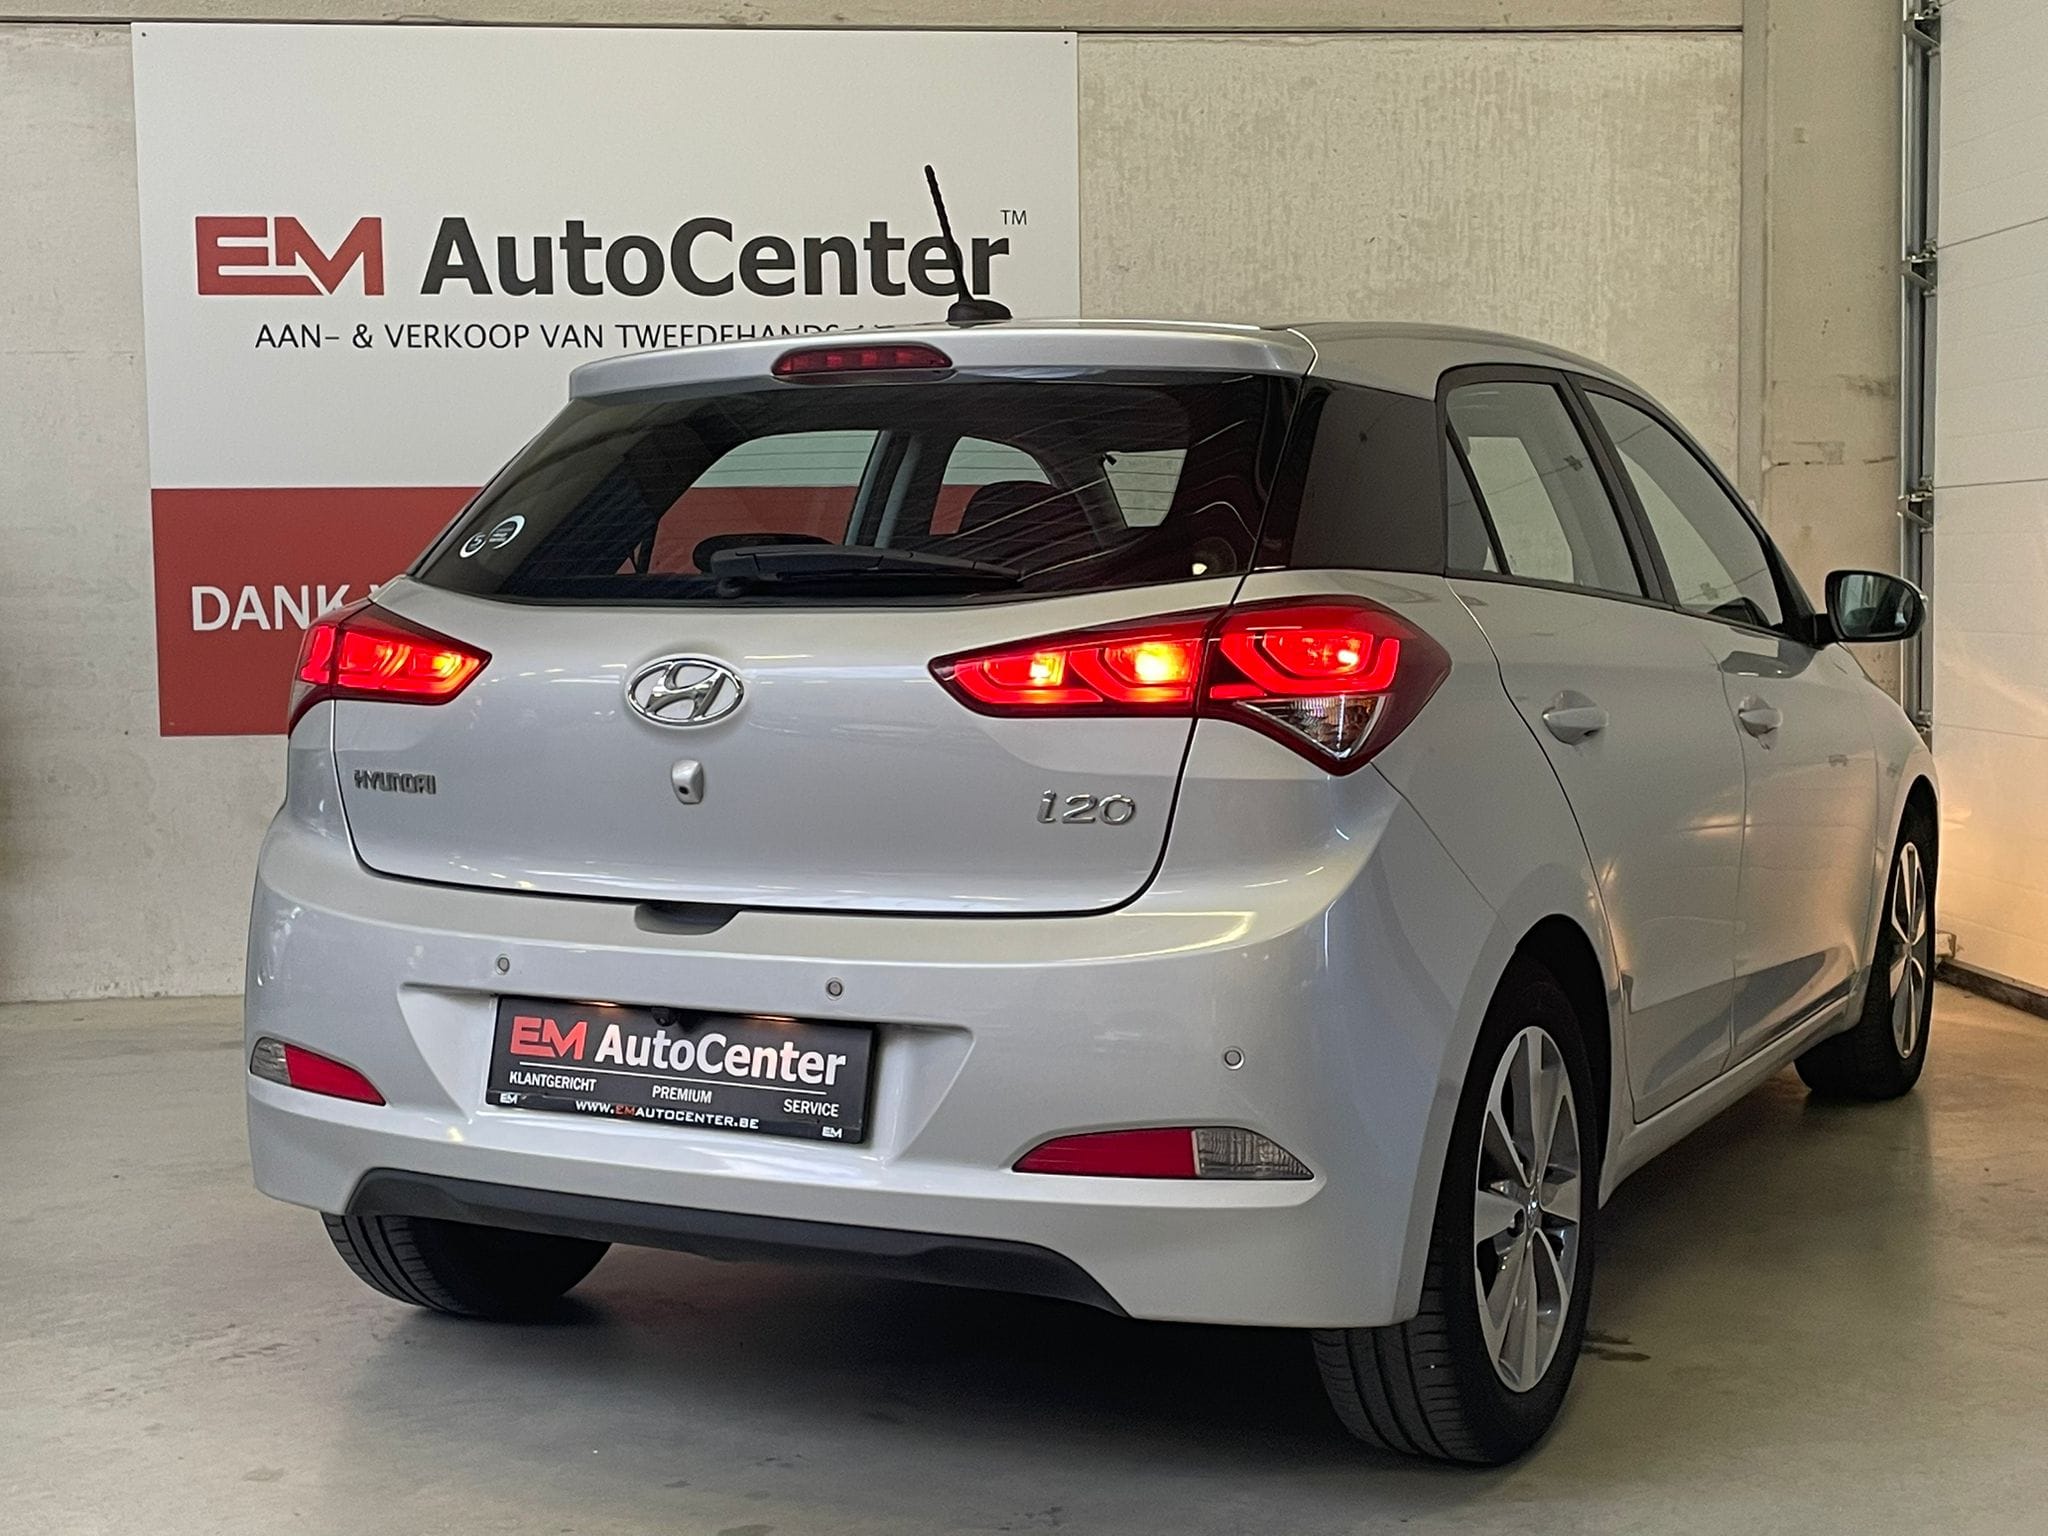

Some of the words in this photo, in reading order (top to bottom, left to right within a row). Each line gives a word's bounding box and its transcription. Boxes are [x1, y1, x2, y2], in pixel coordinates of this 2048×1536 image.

[421, 216, 1009, 297] AutoCenter
[255, 324, 339, 348] AAN-
[352, 324, 373, 348] &
[384, 324, 529, 348] VERKOOP
[540, 324, 603, 348] VAN
[191, 584, 350, 631] DANK
[354, 770, 436, 794] HYUNDAI
[1036, 789, 1136, 826] i20
[510, 1016, 588, 1060] EM
[595, 1024, 846, 1085] AutoCenter
[509, 1071, 597, 1092] KLANTGERICHT
[653, 1085, 713, 1104] PREMIUM
[784, 1099, 839, 1117] SERVICE
[575, 1100, 760, 1130] WWW.EMAUTOCENTER.BE
